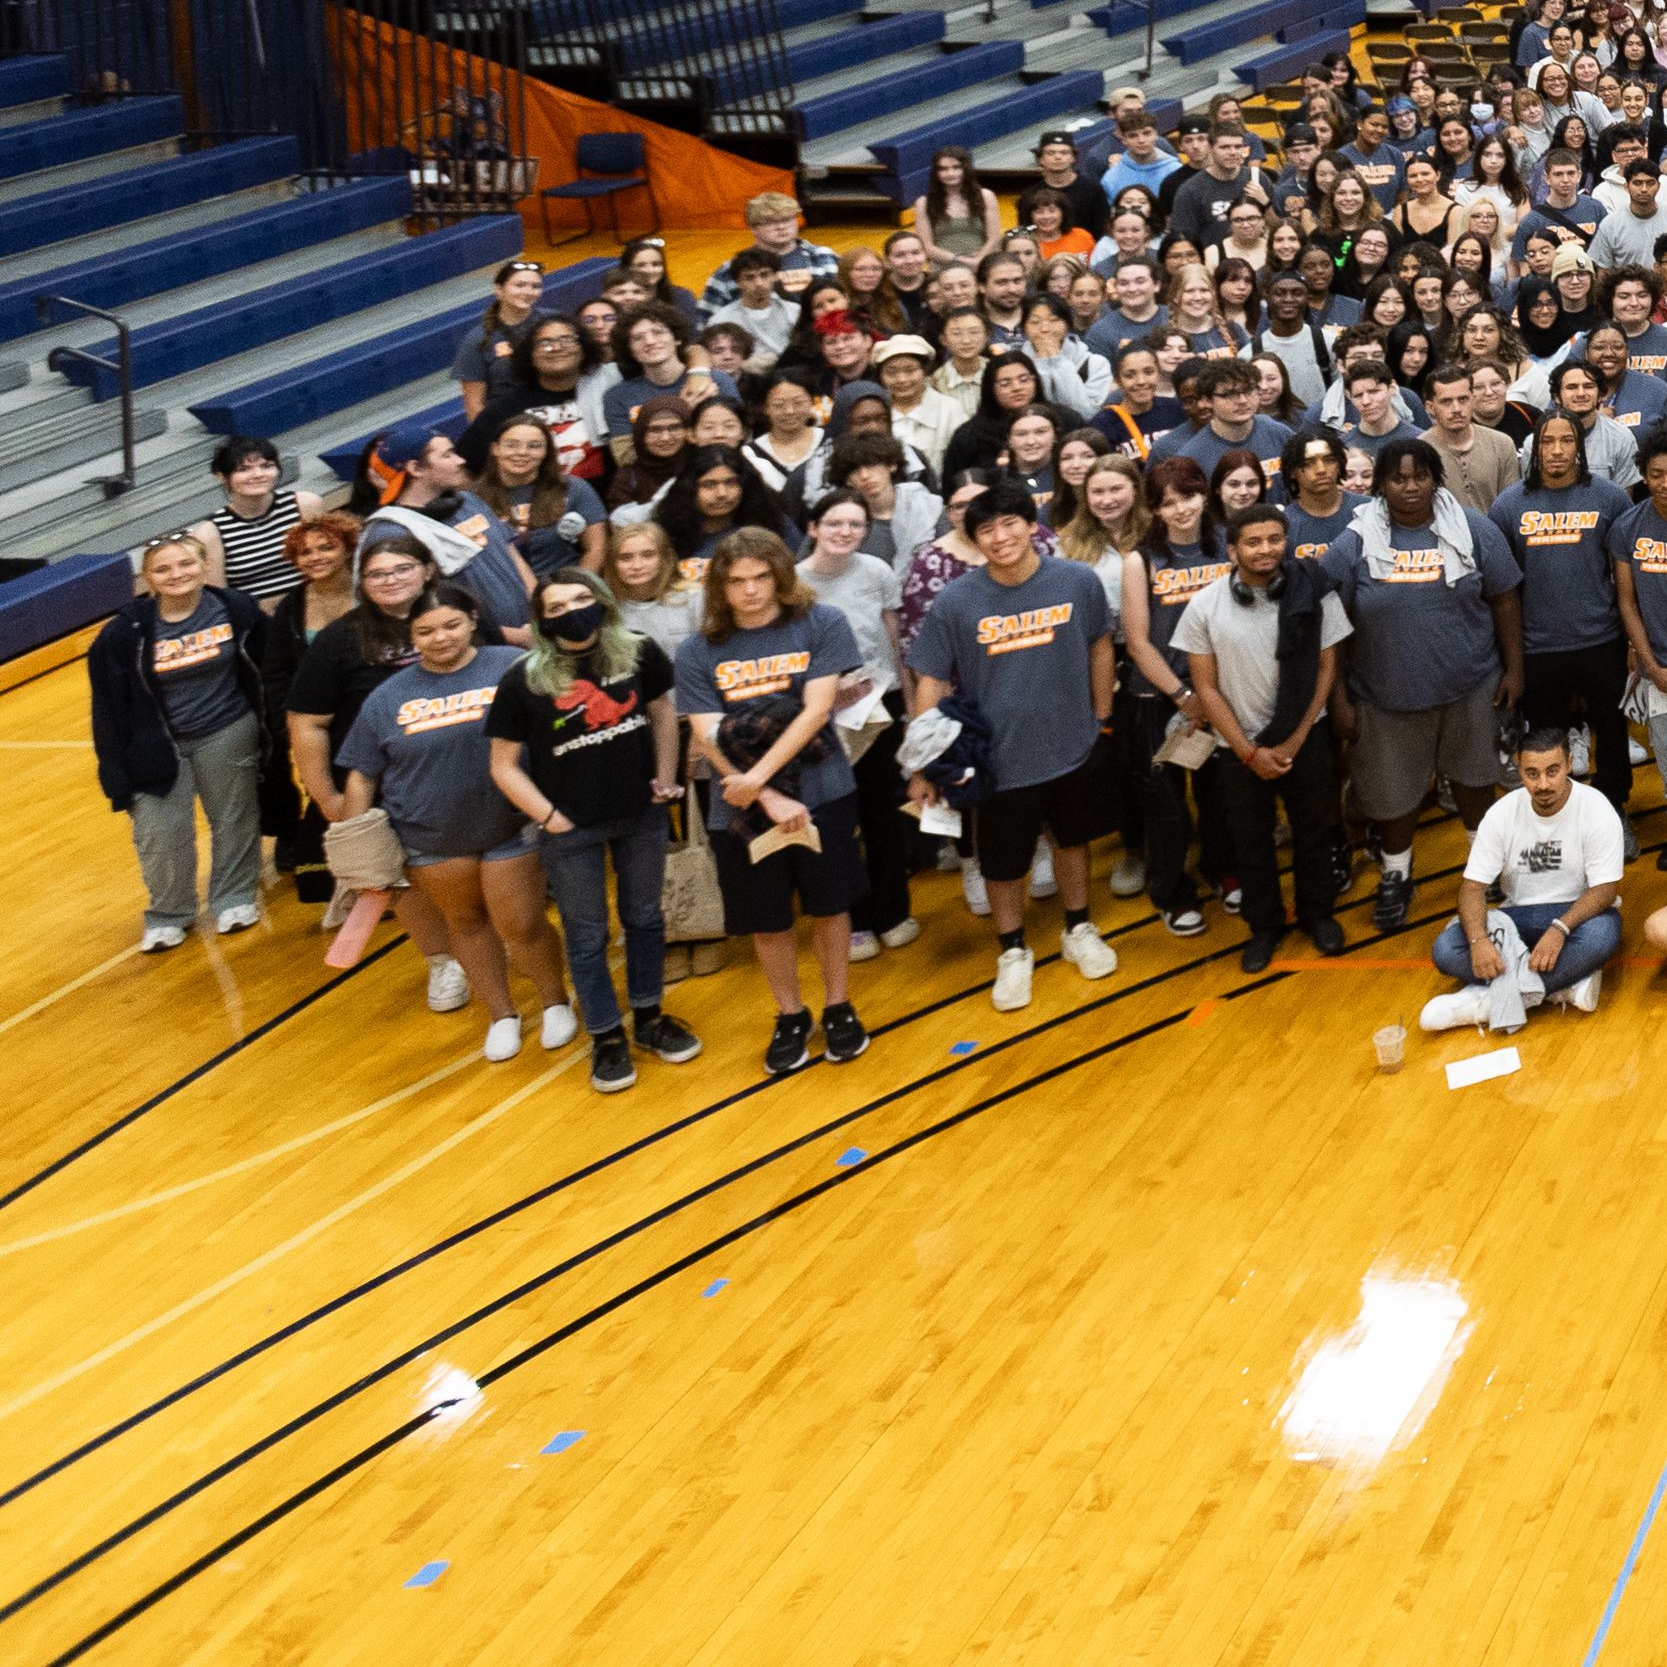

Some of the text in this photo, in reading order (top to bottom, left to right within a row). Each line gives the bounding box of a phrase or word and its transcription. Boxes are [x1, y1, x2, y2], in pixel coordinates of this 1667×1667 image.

[1519, 510, 1600, 535] SALEM
[977, 602, 1073, 644] SALEM
[715, 651, 811, 690] SALEM
